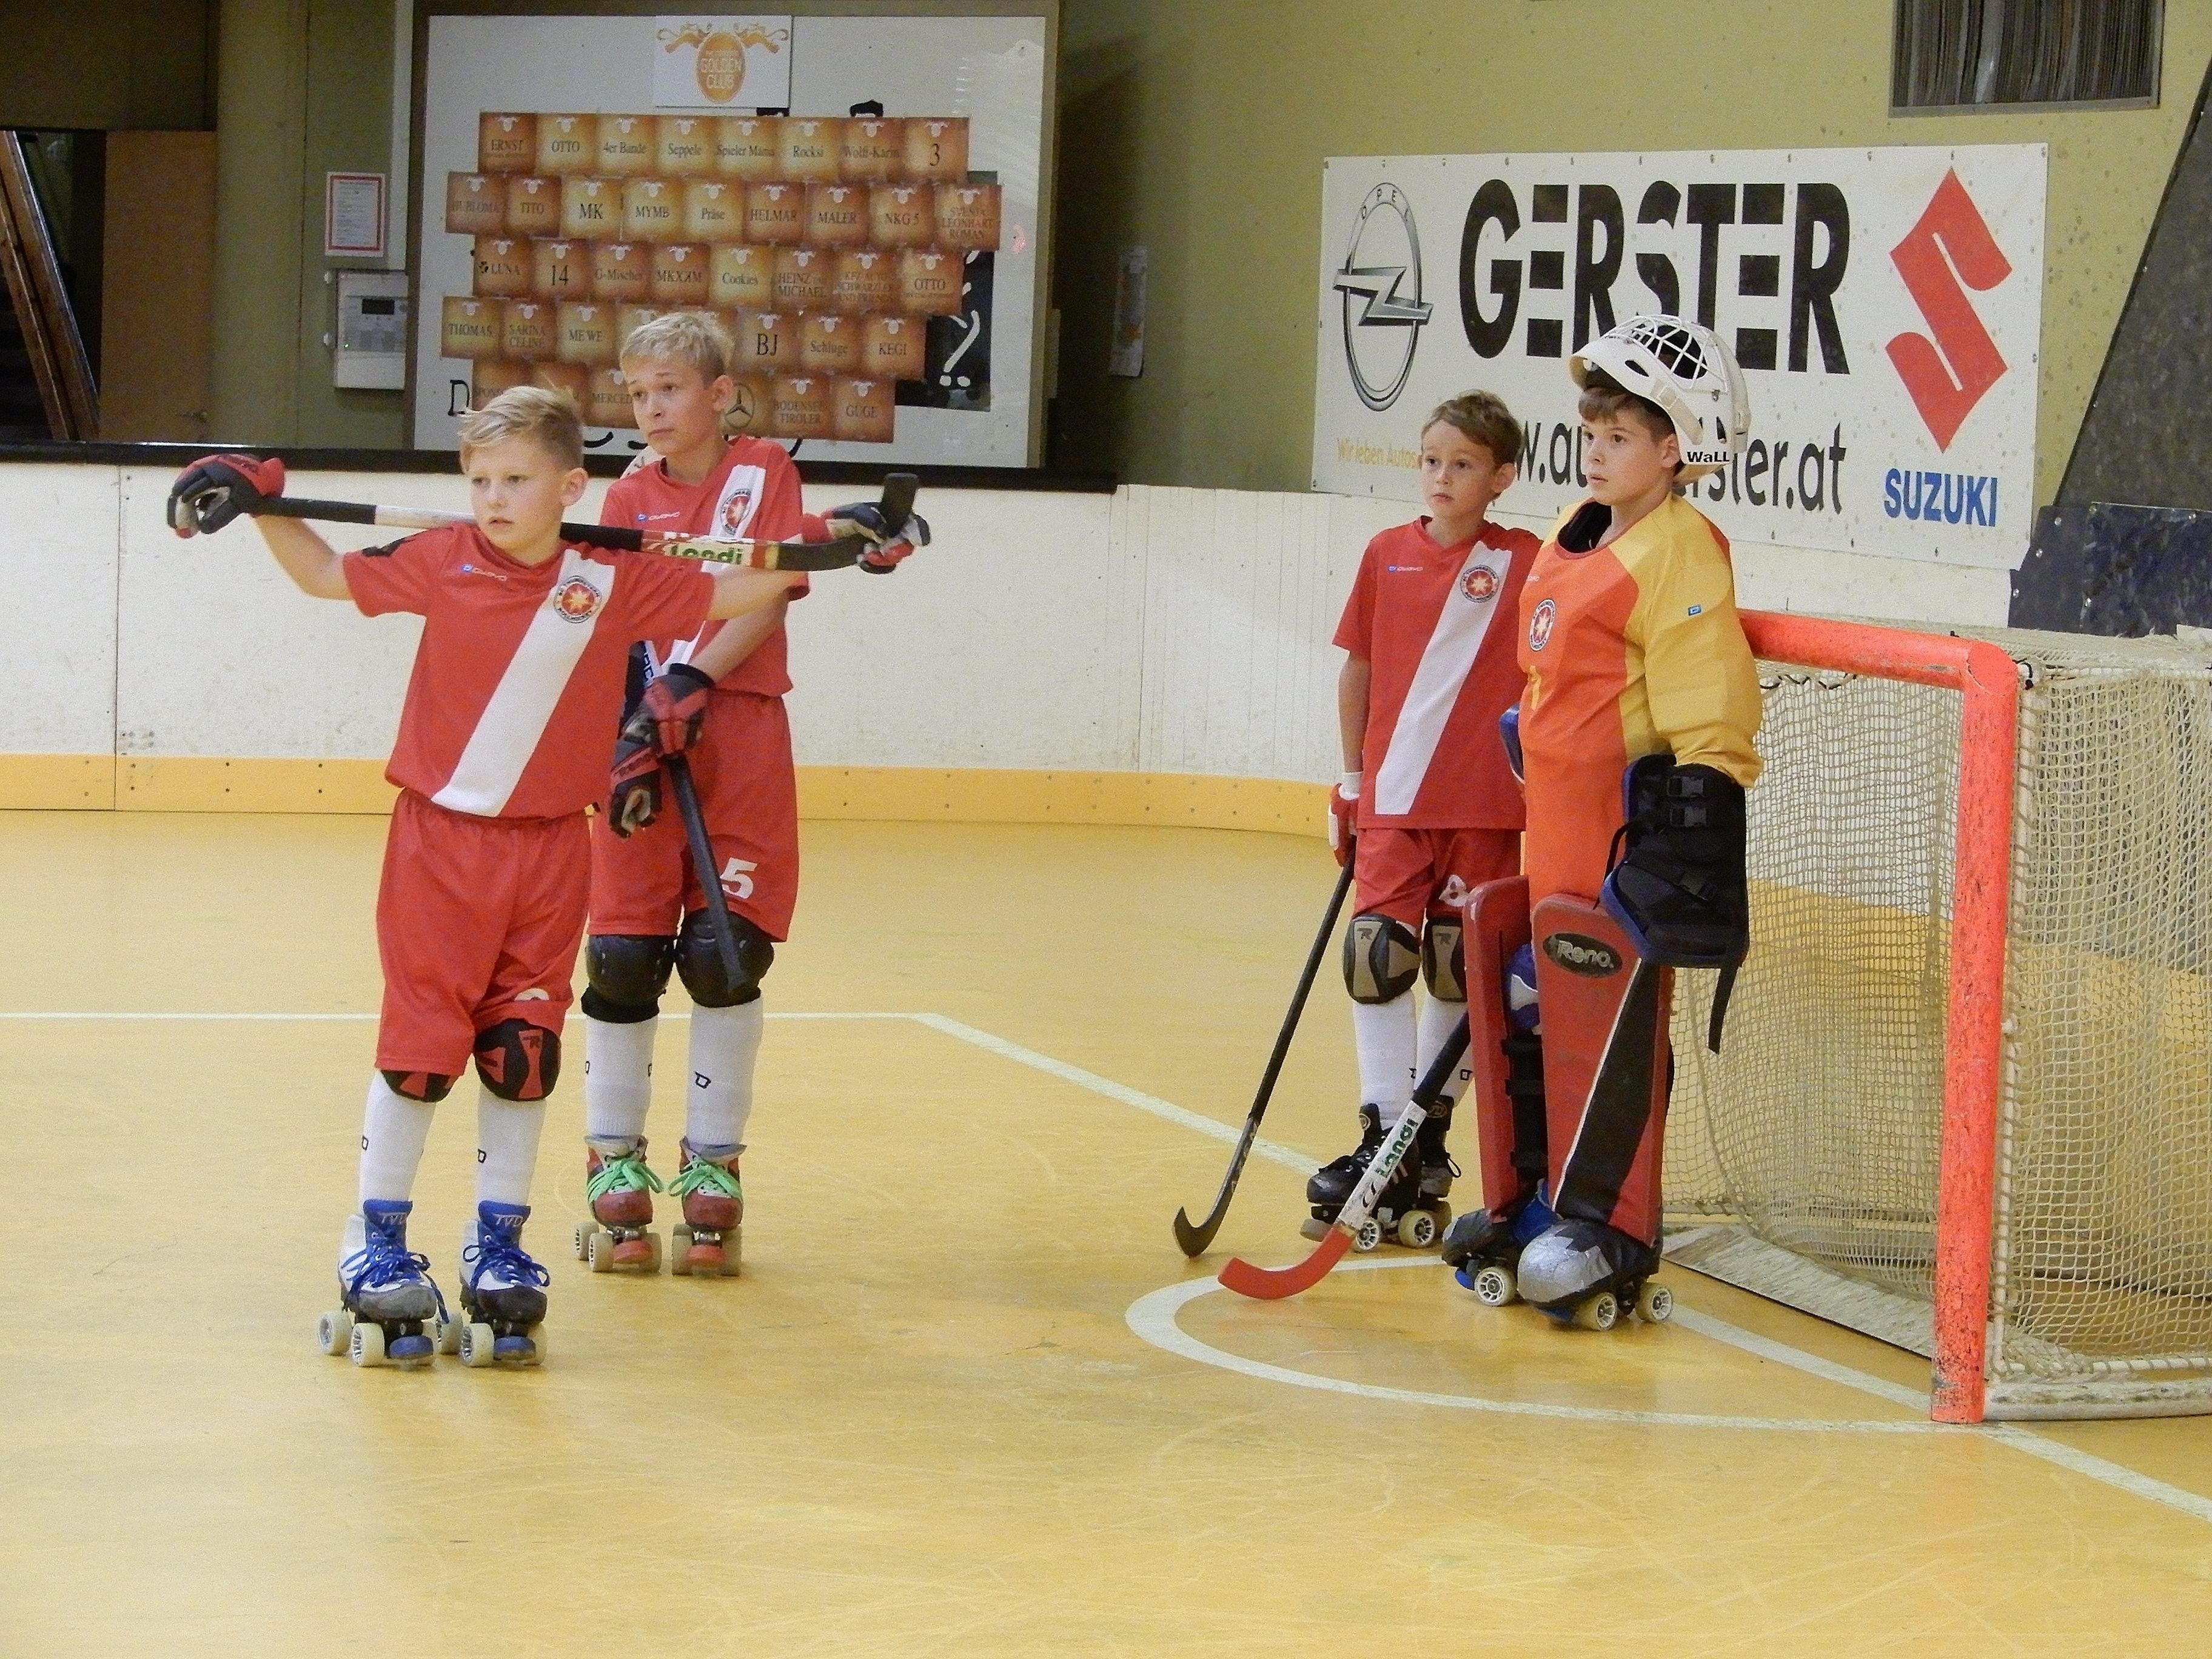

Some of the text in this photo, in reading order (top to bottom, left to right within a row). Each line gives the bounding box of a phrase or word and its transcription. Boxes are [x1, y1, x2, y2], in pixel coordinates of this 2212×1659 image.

[551, 141, 580, 152] OTTO
[929, 143, 940, 166] 3
[579, 203, 603, 220] MK
[818, 212, 857, 224] MALER
[552, 265, 569, 285] 14
[914, 278, 946, 290] OTTO
[1459, 179, 1851, 375] GERSTER
[757, 333, 779, 356] BJ
[1883, 468, 1999, 527] SUZUKI
[719, 857, 758, 899] 5
